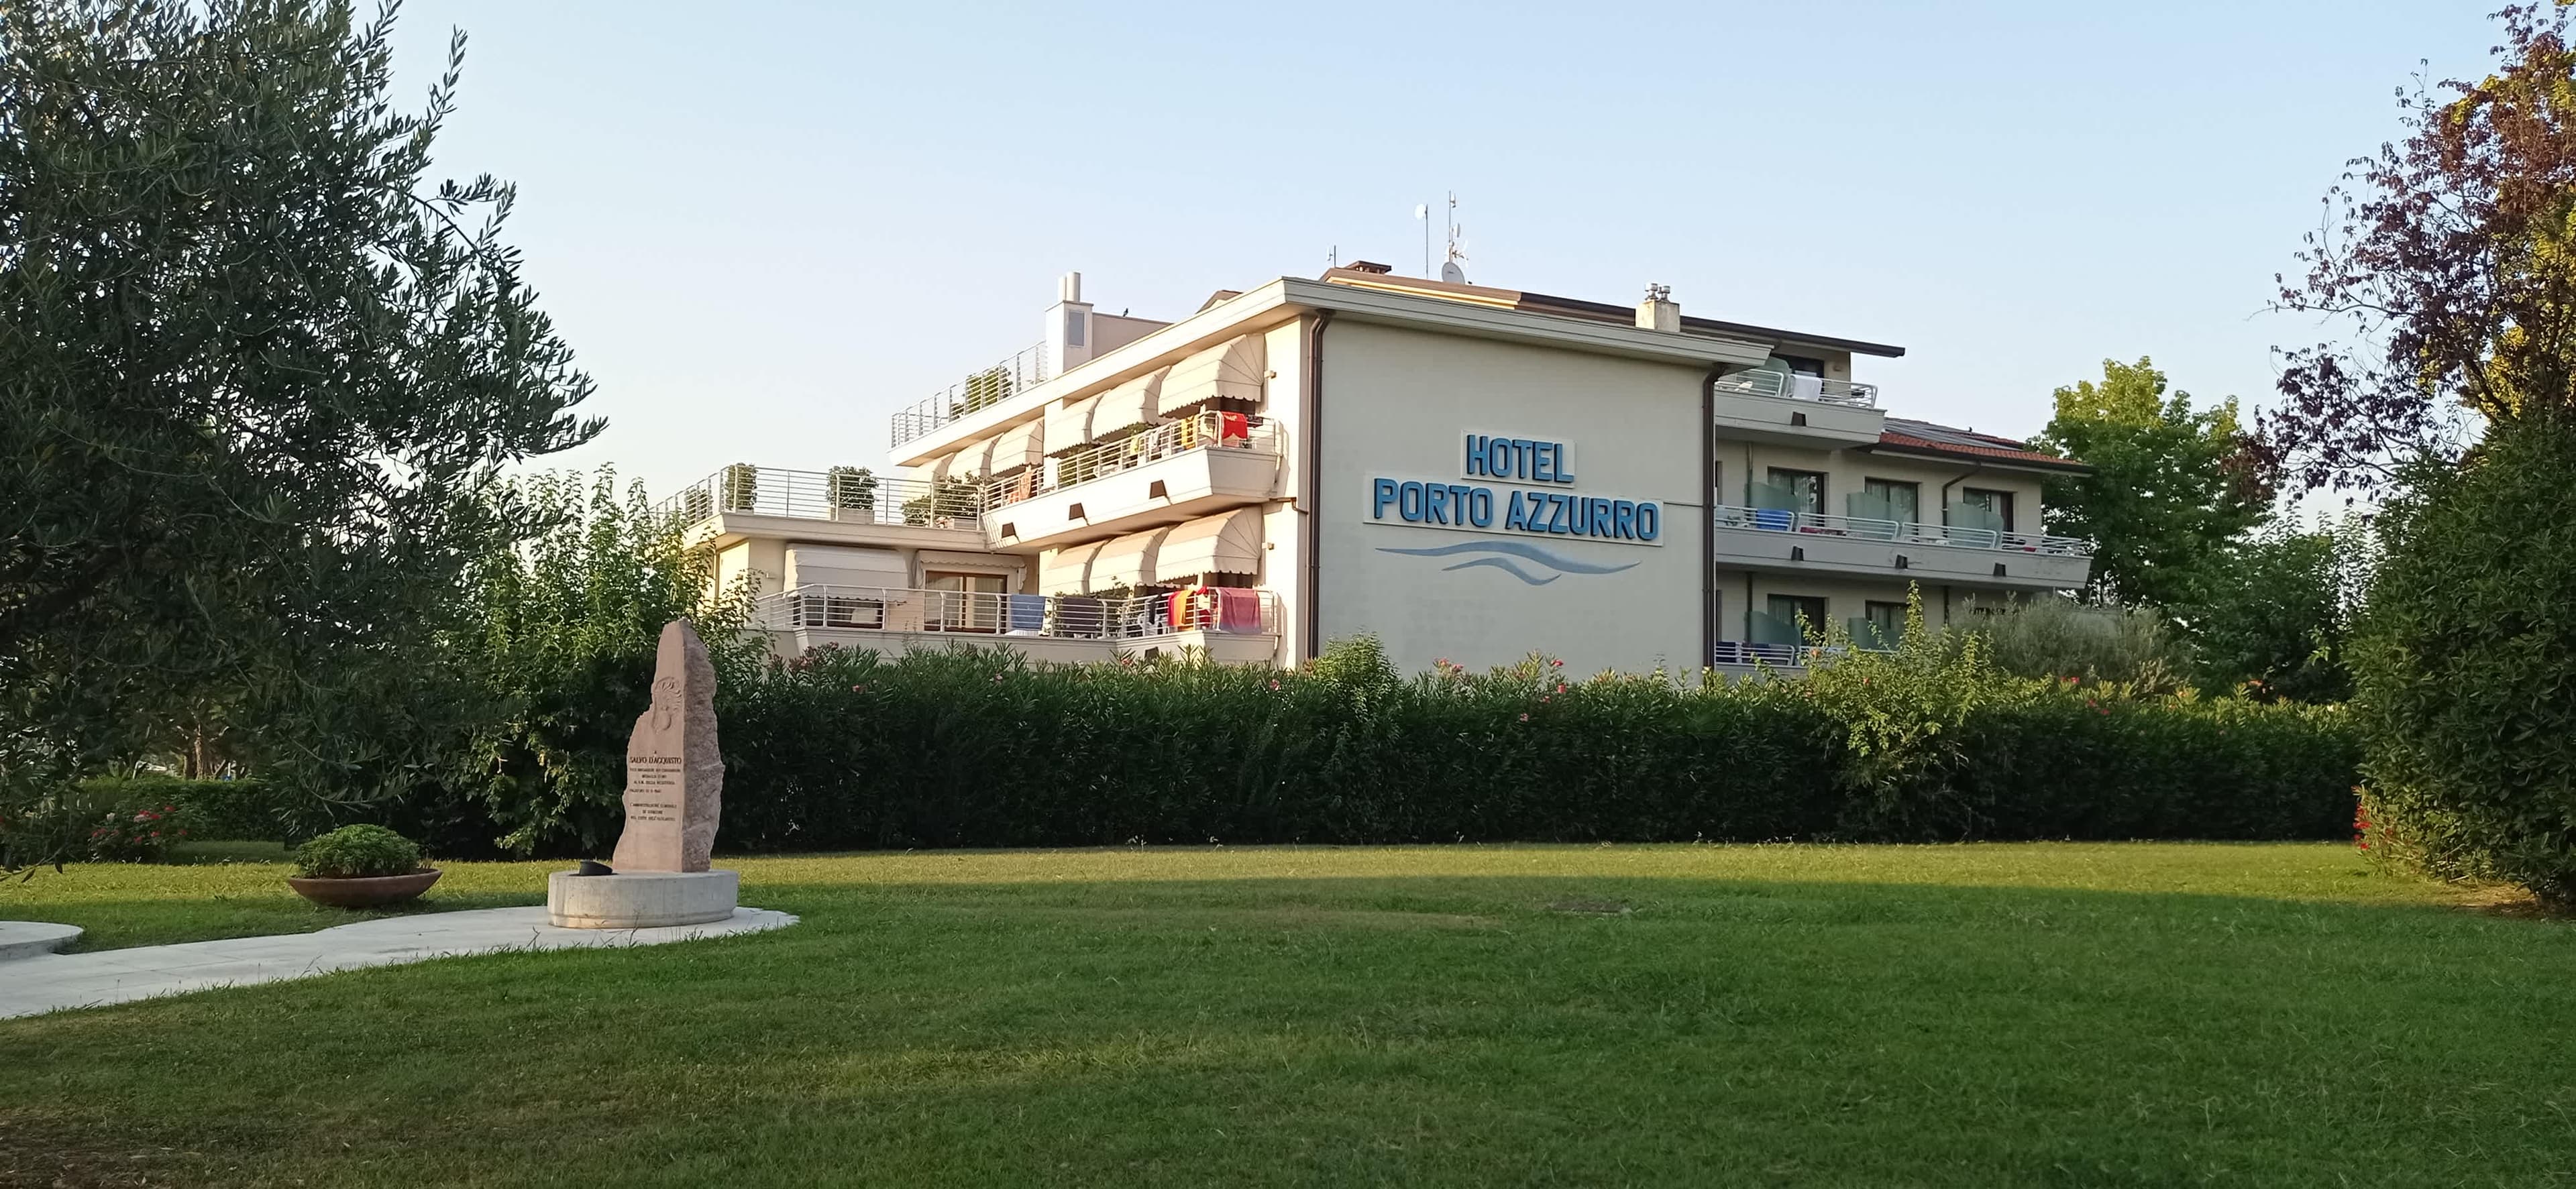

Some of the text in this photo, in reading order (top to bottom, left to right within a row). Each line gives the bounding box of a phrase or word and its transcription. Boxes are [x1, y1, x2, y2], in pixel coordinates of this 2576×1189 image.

[1466, 434, 1574, 483] HOTEL
[1373, 477, 1659, 541] PORTO AZZURRO
